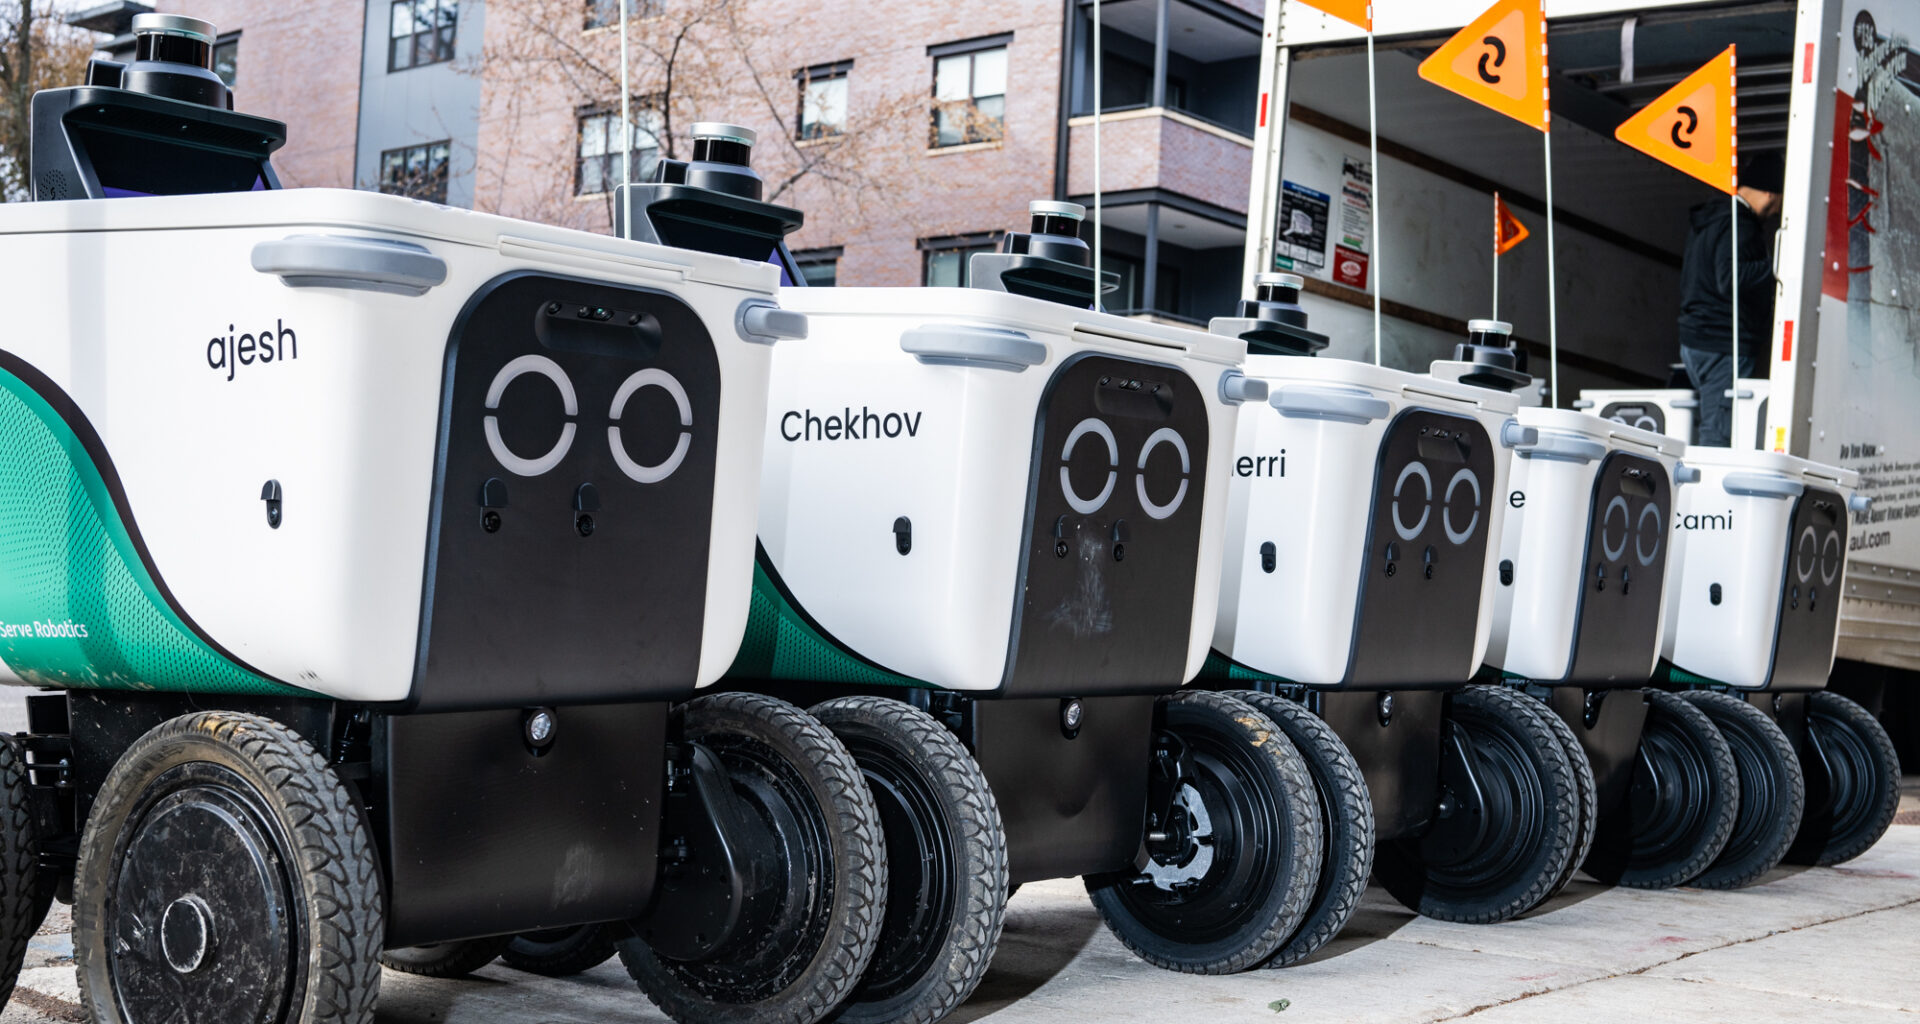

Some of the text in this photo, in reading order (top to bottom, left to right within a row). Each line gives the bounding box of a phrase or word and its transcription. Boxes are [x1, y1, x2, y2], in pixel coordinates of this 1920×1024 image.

[207, 318, 297, 382] ajesh
[780, 406, 922, 442] Chekhov
[1231, 448, 1286, 478] erri
[1849, 530, 1891, 551] aul.com
[0, 618, 88, 638] Serve Robotics
